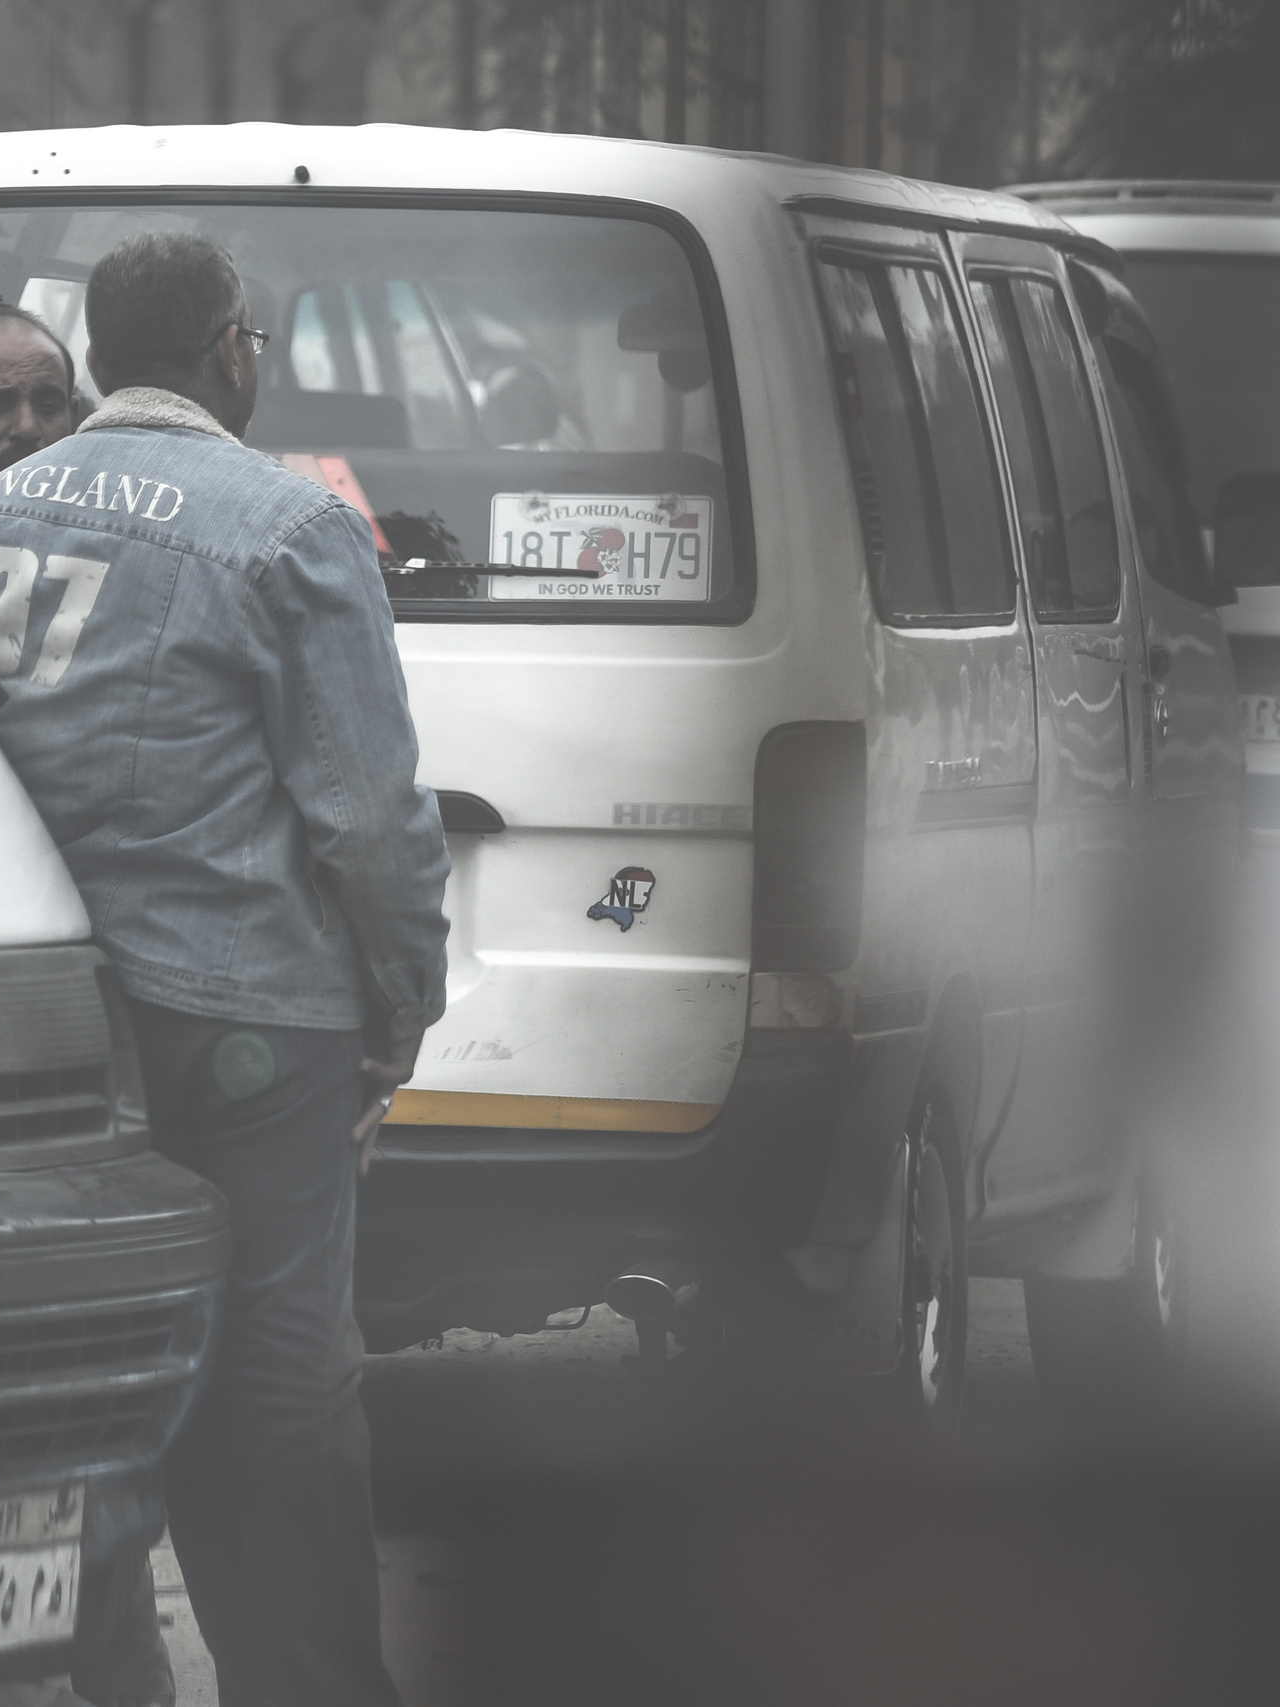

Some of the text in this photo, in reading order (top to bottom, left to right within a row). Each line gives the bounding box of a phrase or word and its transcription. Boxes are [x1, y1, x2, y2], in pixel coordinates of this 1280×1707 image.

[502, 530, 701, 580] 18T H79
[538, 583, 661, 596] IN GOD WE TRUST
[614, 803, 753, 827] HIACE
